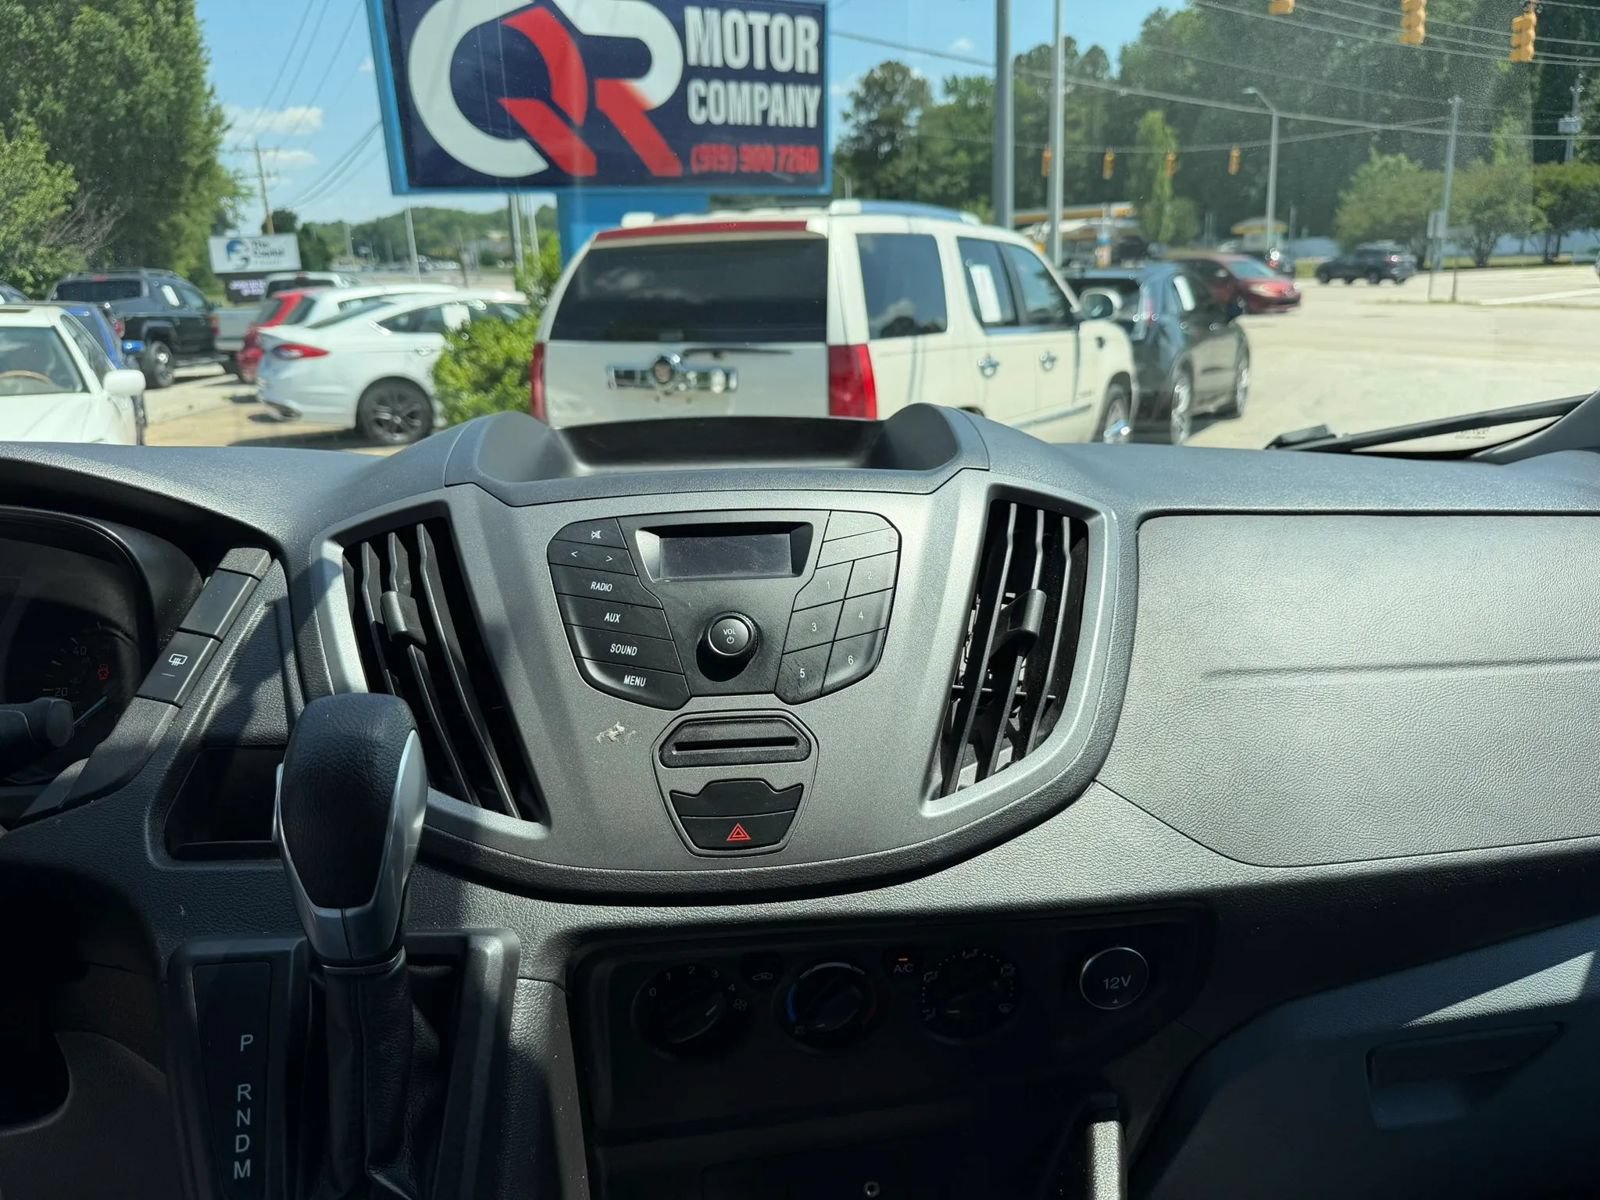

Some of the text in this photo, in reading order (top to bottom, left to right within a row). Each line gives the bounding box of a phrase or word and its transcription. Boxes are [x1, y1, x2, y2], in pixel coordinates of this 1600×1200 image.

[684, 6, 819, 74] MOTOR
[687, 79, 821, 128] COMPANY
[867, 571, 874, 580] 2
[590, 581, 614, 592] RADIO
[603, 612, 621, 624] AUX
[811, 610, 865, 632] 3 4
[723, 627, 738, 636] VOL
[610, 643, 638, 656] SOUND
[799, 655, 855, 679] 5 6
[623, 674, 646, 687] MENU
[54, 688, 69, 697] 20
[1103, 975, 1132, 991] 12V
[240, 1034, 254, 1052] P
[237, 1083, 252, 1103] R
[236, 1107, 251, 1128] N
[235, 1134, 250, 1153] D
[233, 1158, 251, 1180] M
